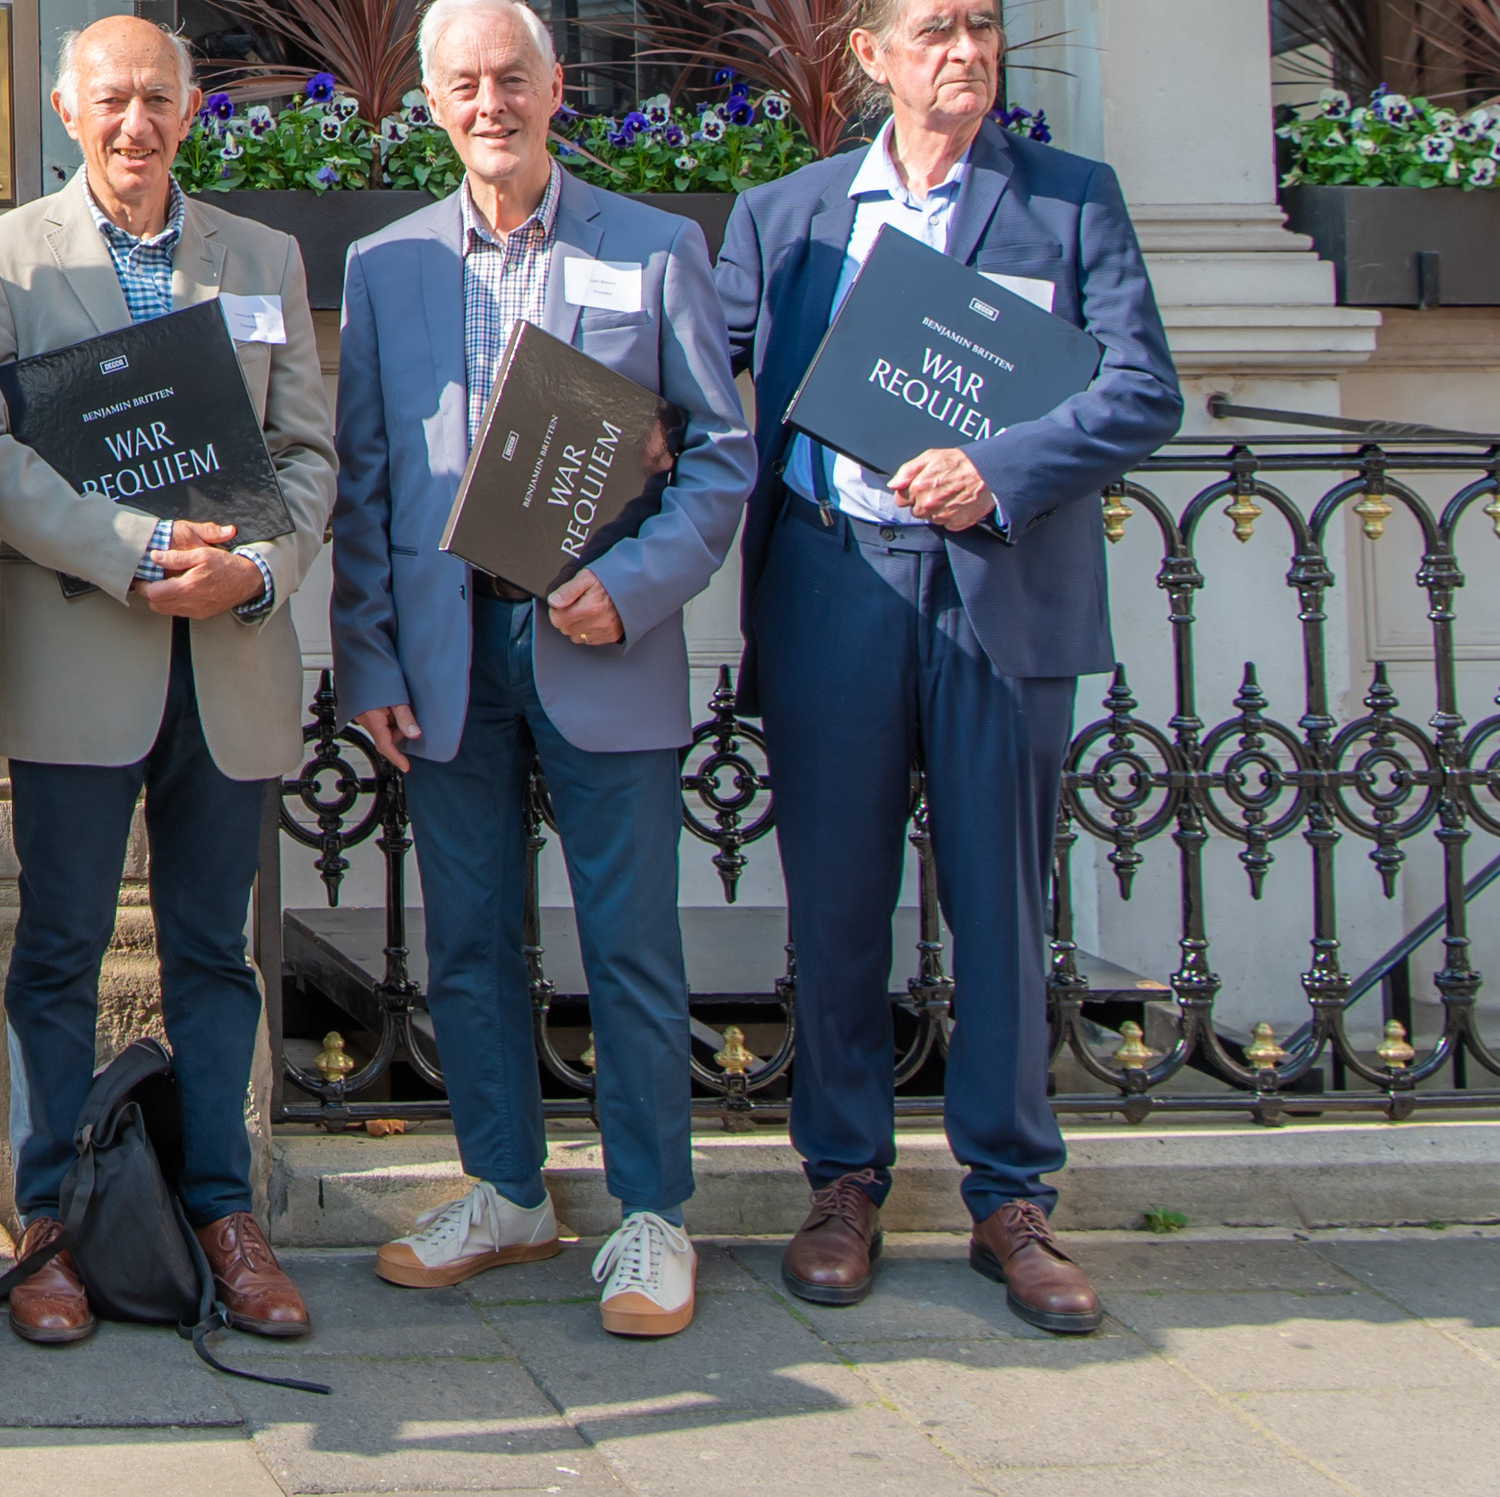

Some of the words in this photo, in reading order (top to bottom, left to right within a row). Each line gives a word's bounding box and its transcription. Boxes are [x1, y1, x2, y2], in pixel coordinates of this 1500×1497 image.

[922, 316, 973, 349] BENJAMIN
[971, 344, 1015, 373] BRITTEN
[921, 347, 985, 404] WAR
[82, 400, 132, 422] BENJAMIN
[132, 387, 175, 408] BRITTEN
[104, 421, 176, 462] WAR
[522, 457, 545, 509] BENJAMIN
[539, 414, 559, 458] BRITTEN
[547, 444, 587, 507] WAR
[560, 419, 622, 560] REQUIEM
